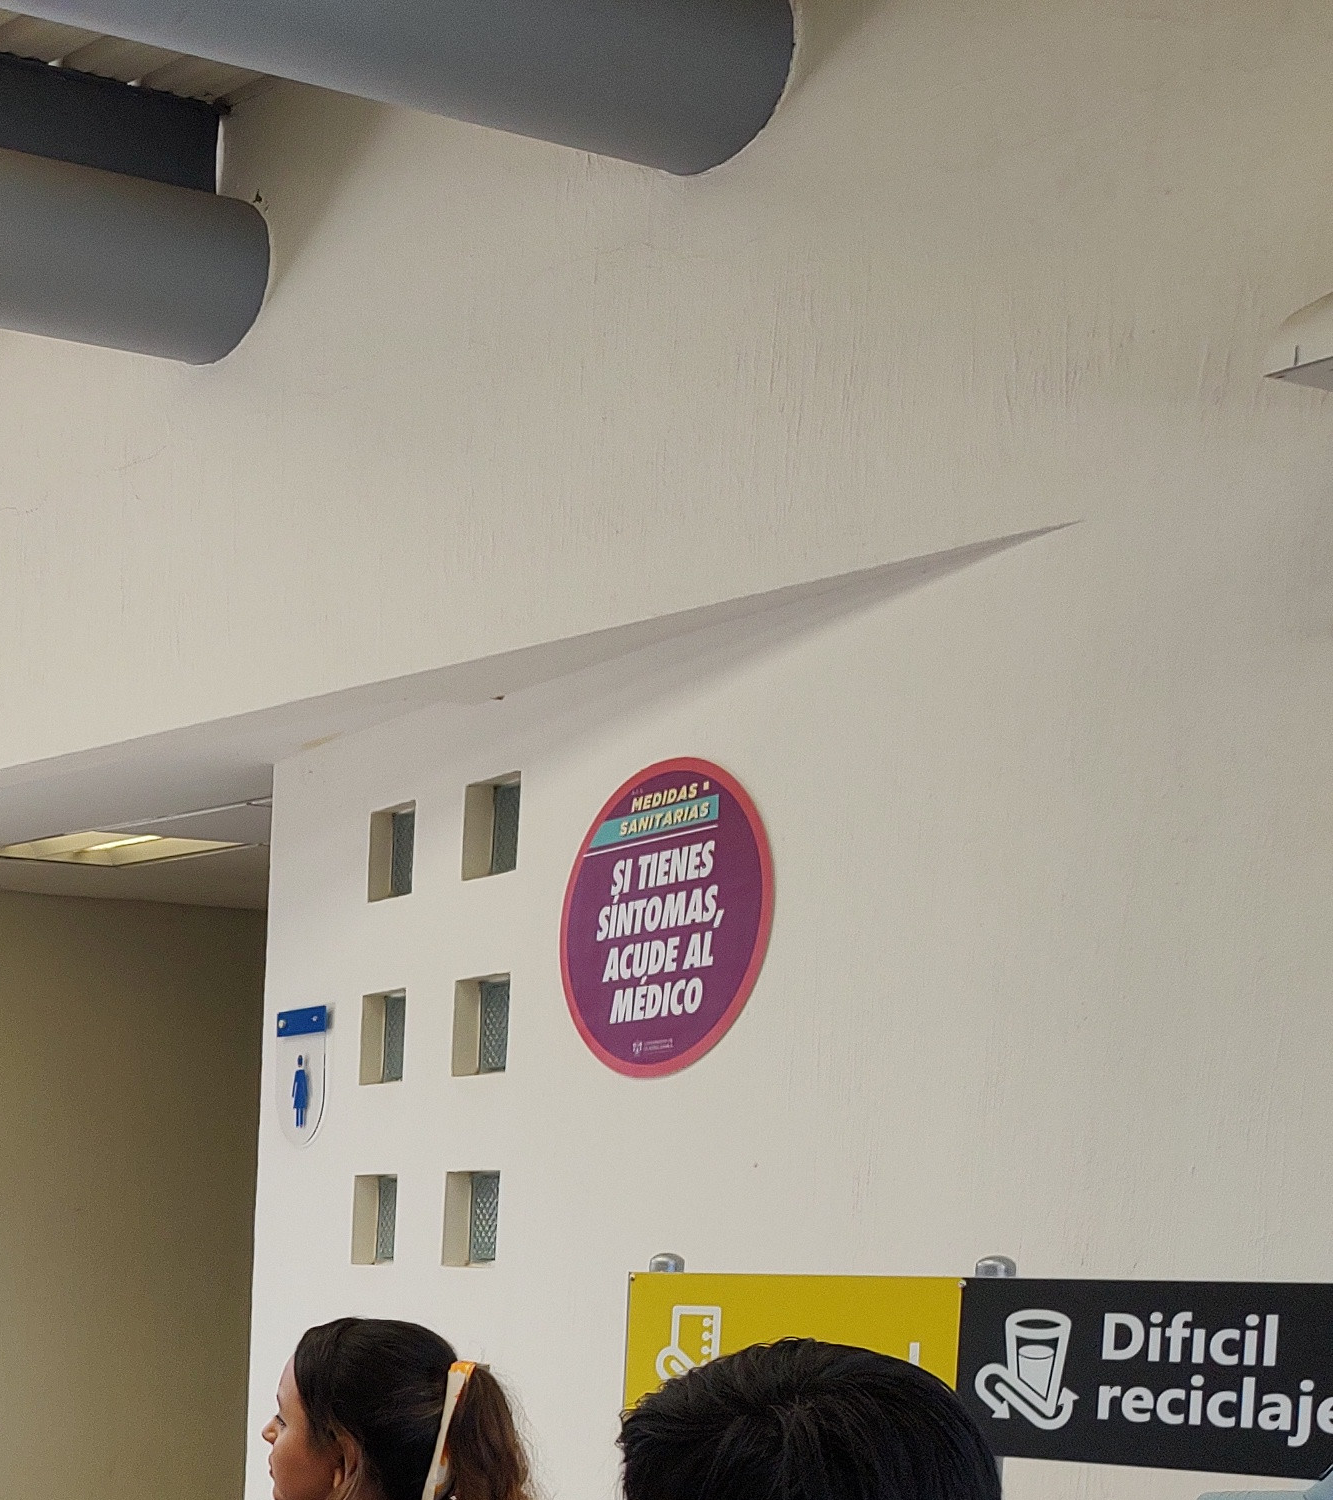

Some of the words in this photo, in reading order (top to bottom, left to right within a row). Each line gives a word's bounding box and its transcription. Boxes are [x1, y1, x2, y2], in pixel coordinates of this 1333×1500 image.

[620, 802, 710, 836] SANITARIAS
[631, 783, 698, 812] MEDIDAS
[611, 858, 632, 895] SI
[638, 840, 715, 890] TIENES
[596, 884, 724, 941] SÍNTOMAS,
[602, 936, 680, 982] ACUDE
[683, 931, 713, 970] AL
[610, 975, 703, 1024] MÉDICO
[1096, 1375, 1333, 1447] reciclaje
